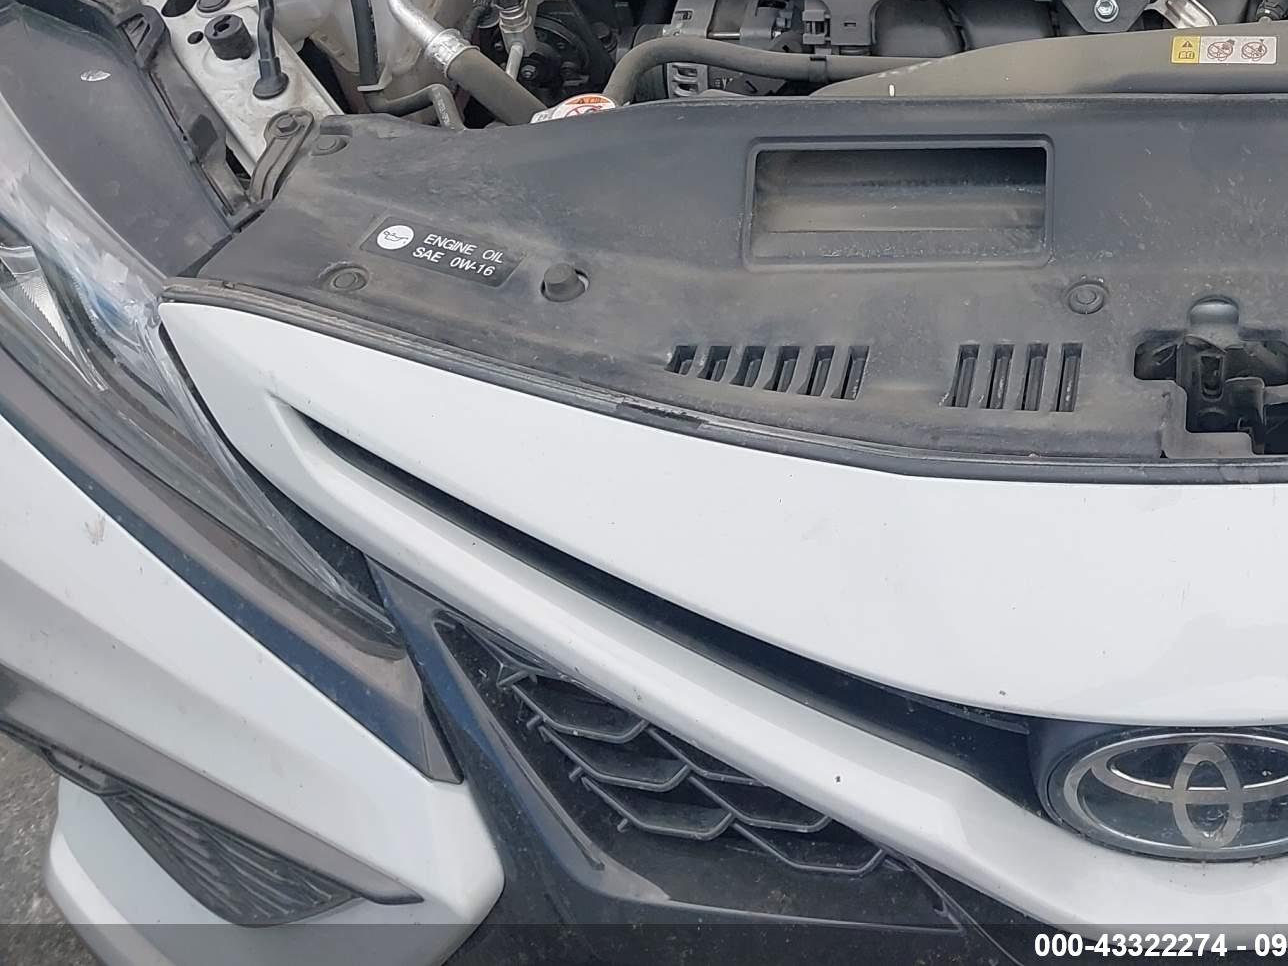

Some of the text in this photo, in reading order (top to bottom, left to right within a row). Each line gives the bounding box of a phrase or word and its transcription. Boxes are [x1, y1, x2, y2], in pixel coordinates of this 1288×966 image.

[412, 246, 496, 276] SAE 0W-16
[423, 233, 504, 264] ENGINE OIL
